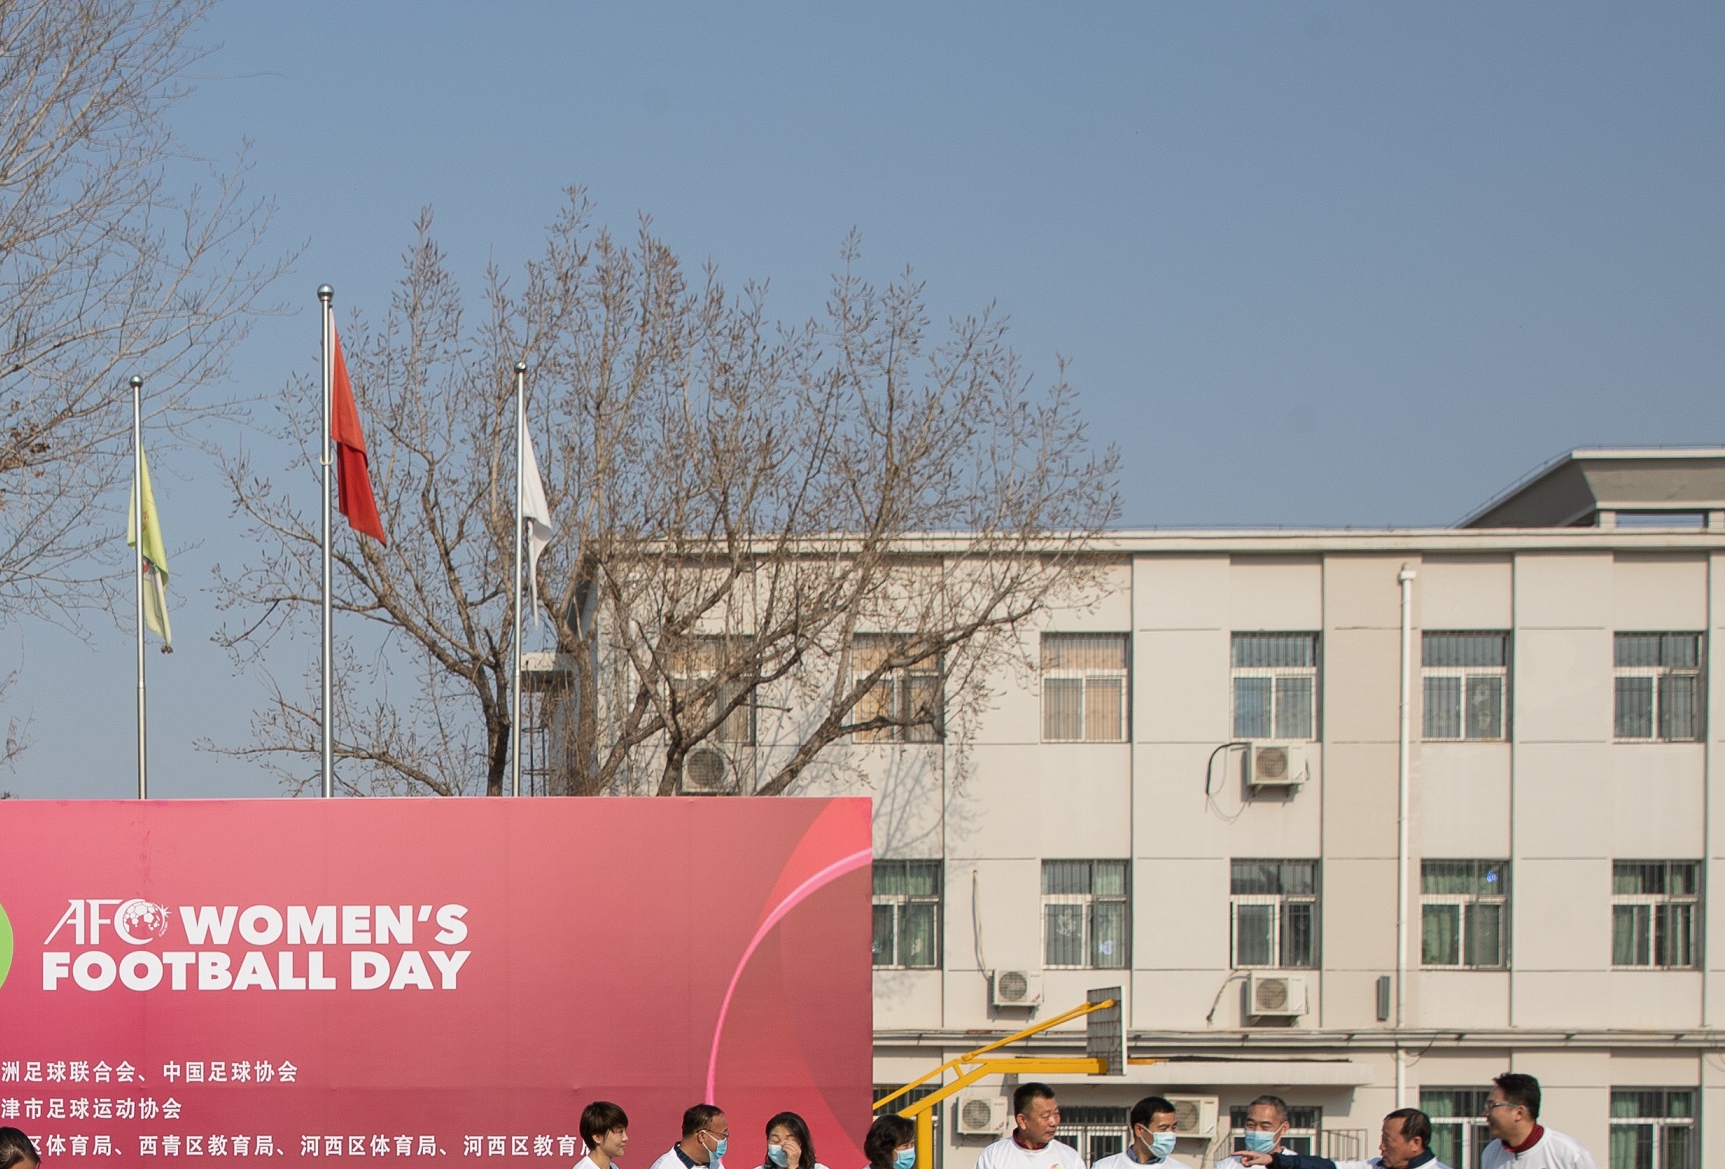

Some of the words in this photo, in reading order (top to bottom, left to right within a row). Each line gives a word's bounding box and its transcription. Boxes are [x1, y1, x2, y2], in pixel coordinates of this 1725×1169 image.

[43, 898, 158, 945] AFC
[180, 904, 469, 946] WOMEN'S
[43, 950, 336, 991] FOOTBALL
[350, 950, 472, 990] DAY
